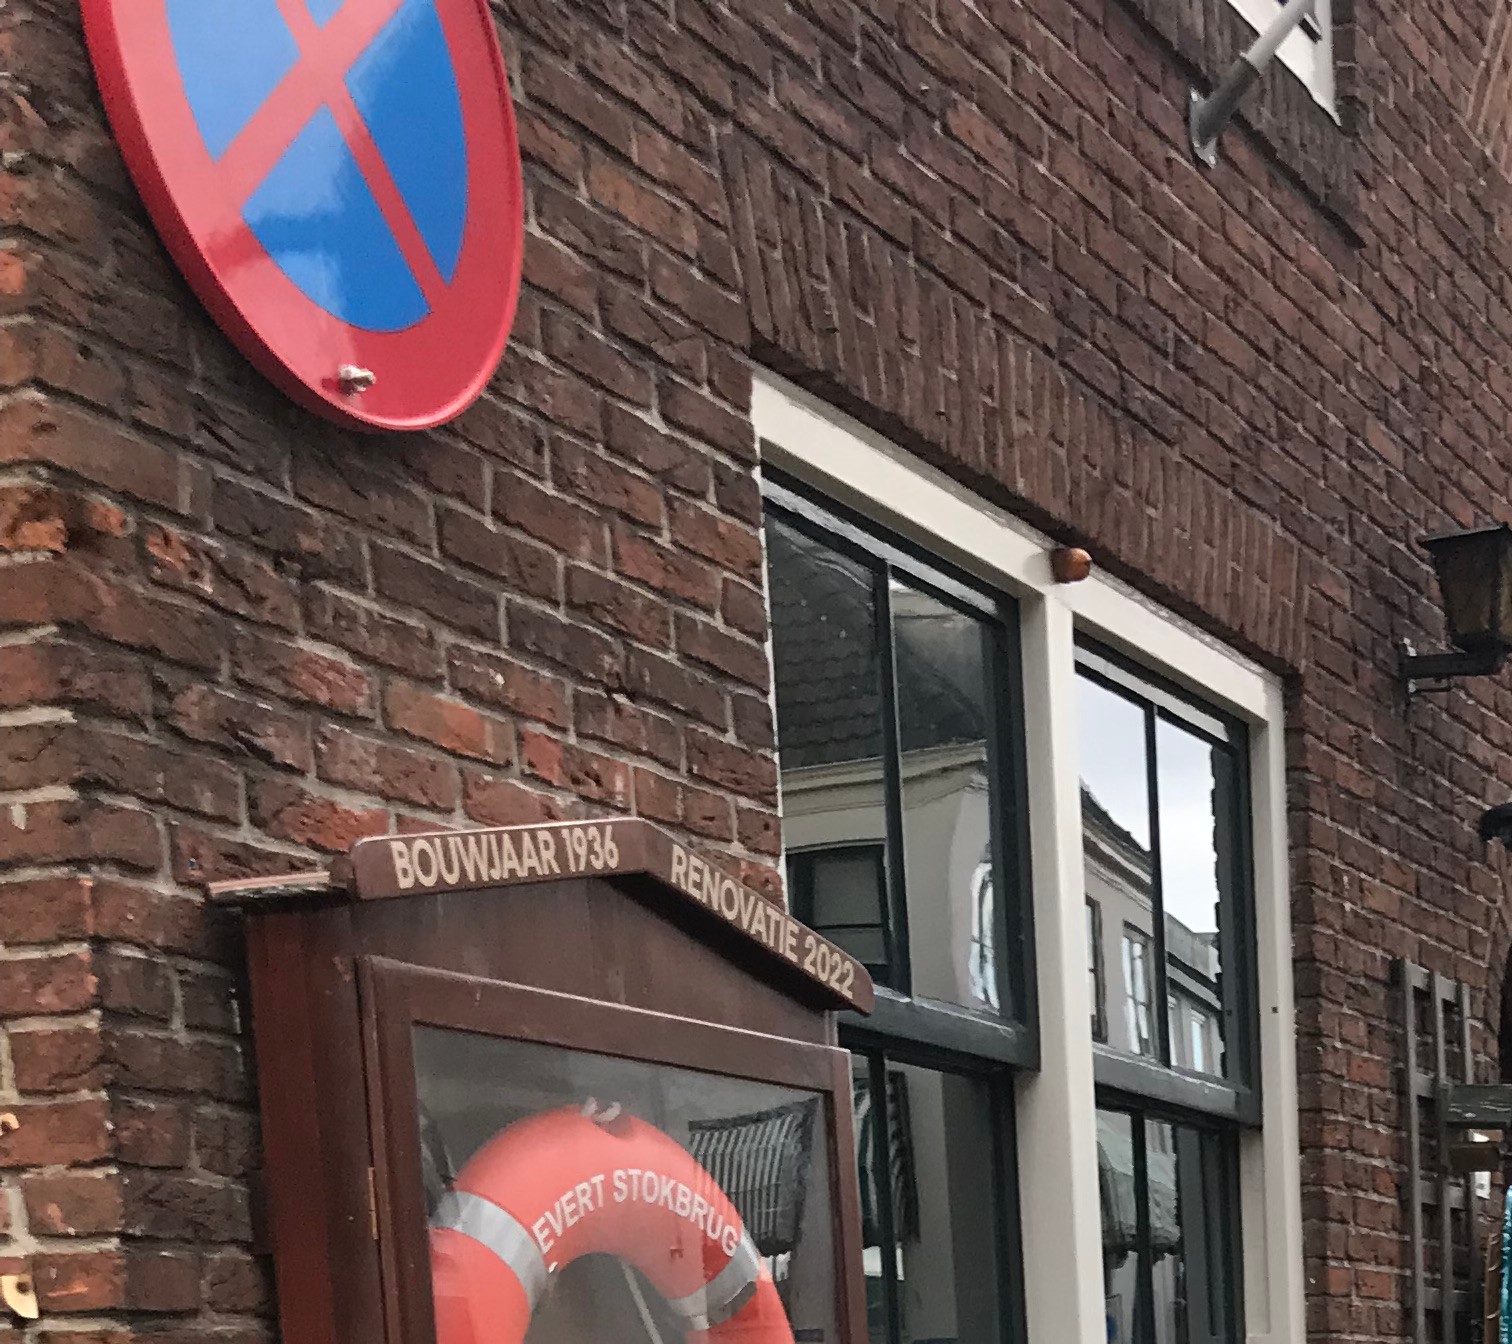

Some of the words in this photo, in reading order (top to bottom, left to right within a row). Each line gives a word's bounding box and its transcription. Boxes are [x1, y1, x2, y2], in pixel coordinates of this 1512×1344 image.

[390, 830, 561, 889] BOUWJAAR
[561, 825, 619, 872] 1936
[671, 844, 800, 962] RENOVATIE
[804, 936, 854, 999] 2022
[532, 1174, 605, 1255] EVERT
[612, 1168, 742, 1257] STOKBRUG
